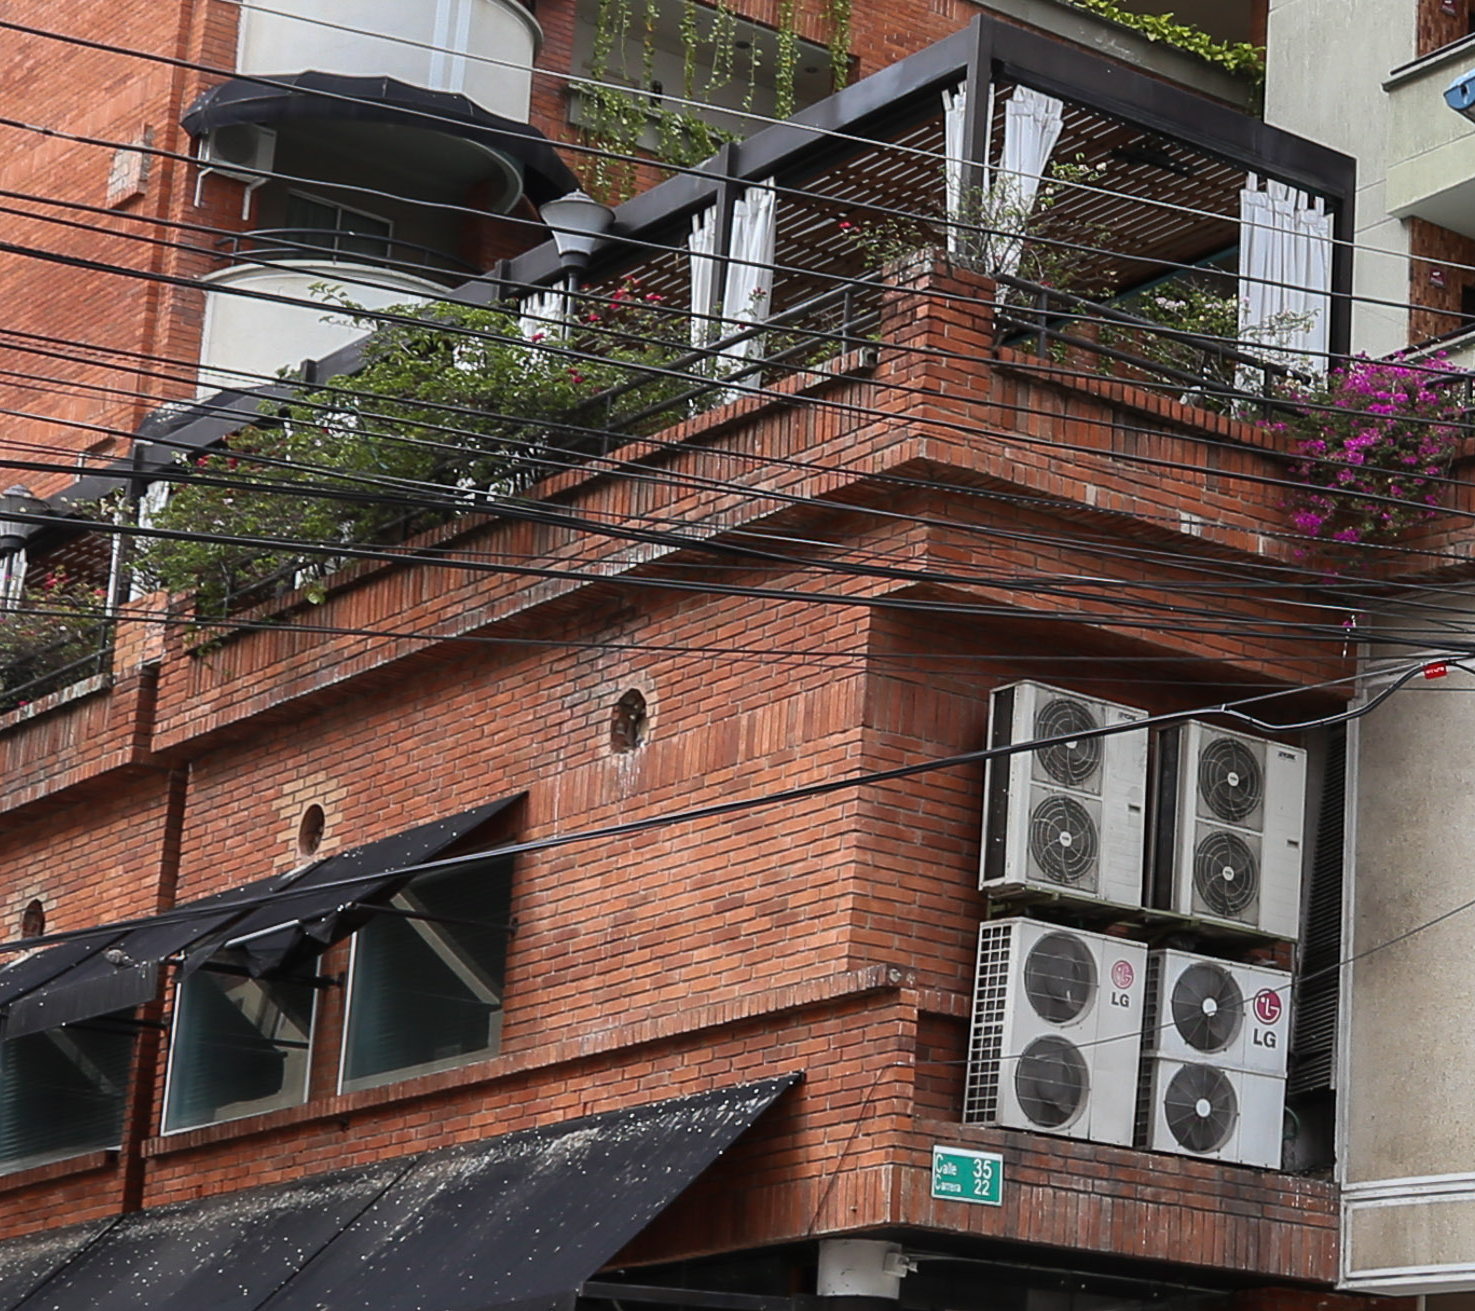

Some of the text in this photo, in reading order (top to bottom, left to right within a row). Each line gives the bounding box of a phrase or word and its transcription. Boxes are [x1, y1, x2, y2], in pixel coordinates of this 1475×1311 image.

[1111, 992, 1129, 1007] LG
[1253, 1029, 1276, 1049] LG
[936, 1153, 992, 1179] Calle 35
[974, 1179, 990, 1196] 22
